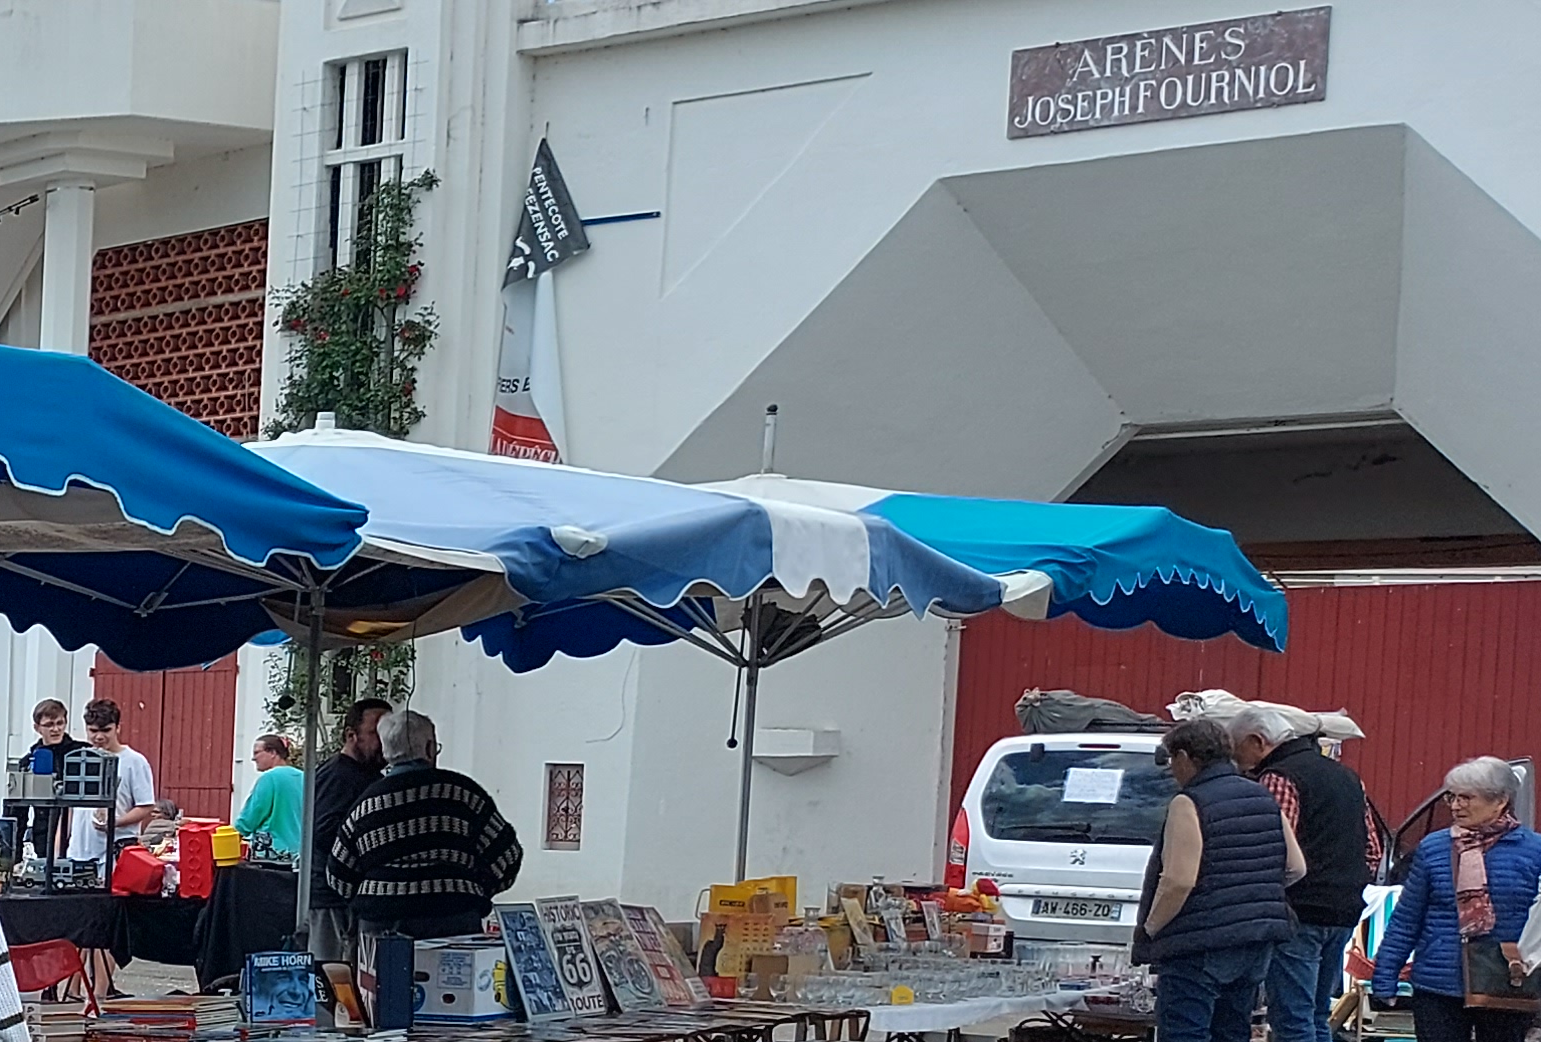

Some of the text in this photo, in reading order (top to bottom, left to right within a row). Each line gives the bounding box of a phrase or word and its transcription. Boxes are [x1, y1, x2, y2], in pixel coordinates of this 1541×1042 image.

[1071, 27, 1246, 82] ARÈNES
[1014, 59, 1316, 129] JOSEPH FOURNIOL
[253, 954, 312, 967] MIKE HORN
[561, 952, 592, 985] 66
